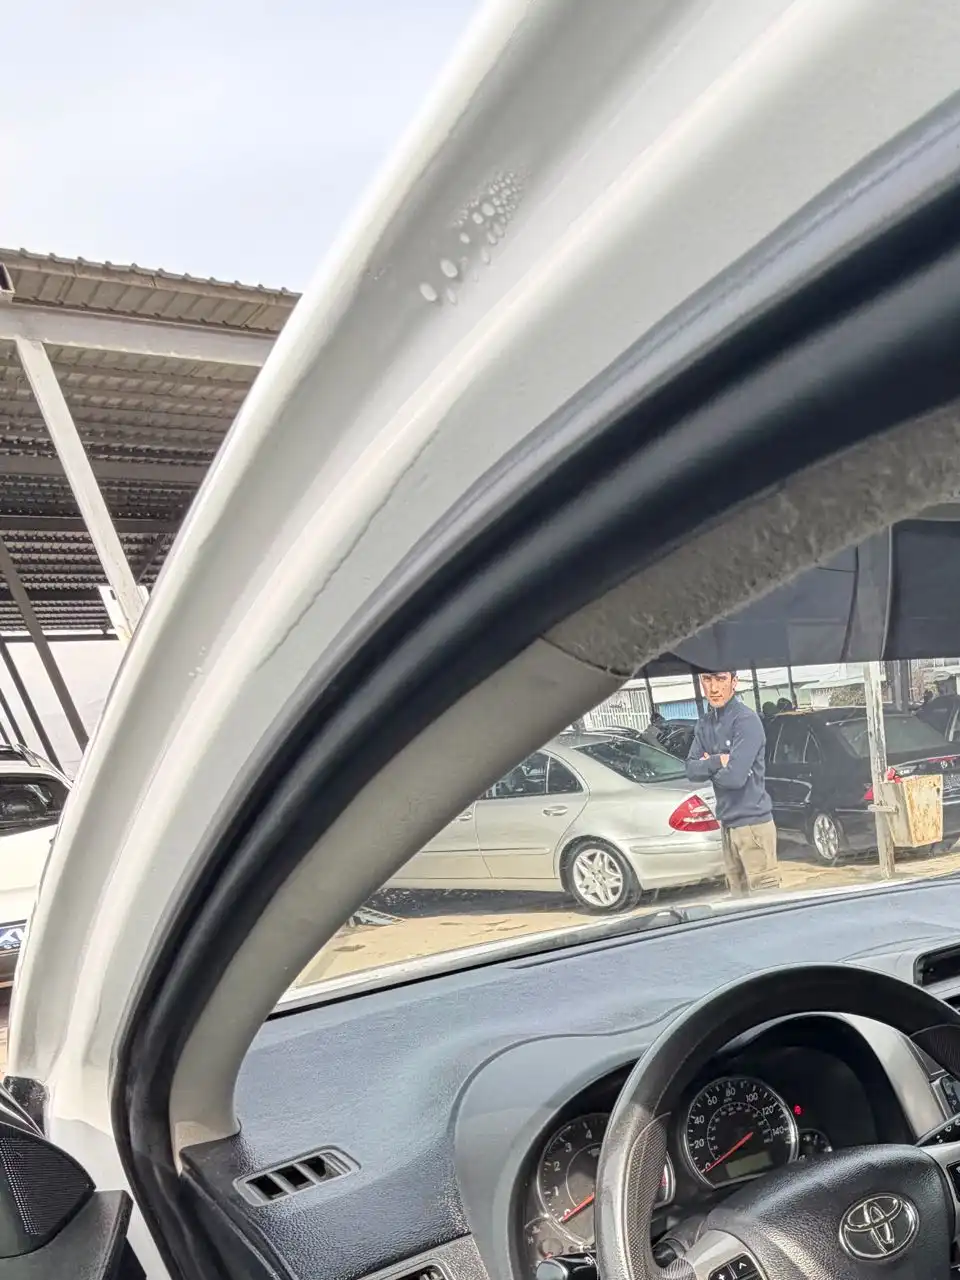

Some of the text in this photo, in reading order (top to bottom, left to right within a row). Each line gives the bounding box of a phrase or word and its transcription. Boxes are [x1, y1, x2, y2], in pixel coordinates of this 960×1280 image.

[725, 1087, 736, 1097] 80
[746, 1092, 758, 1102] 100
[707, 1095, 718, 1106] 60
[762, 1105, 774, 1115] 120
[694, 1115, 705, 1125] 40
[585, 1128, 593, 1139] 4
[772, 1126, 785, 1136] 140
[564, 1142, 573, 1153] 3
[694, 1138, 705, 1149] 20
[553, 1161, 561, 1172] 2
